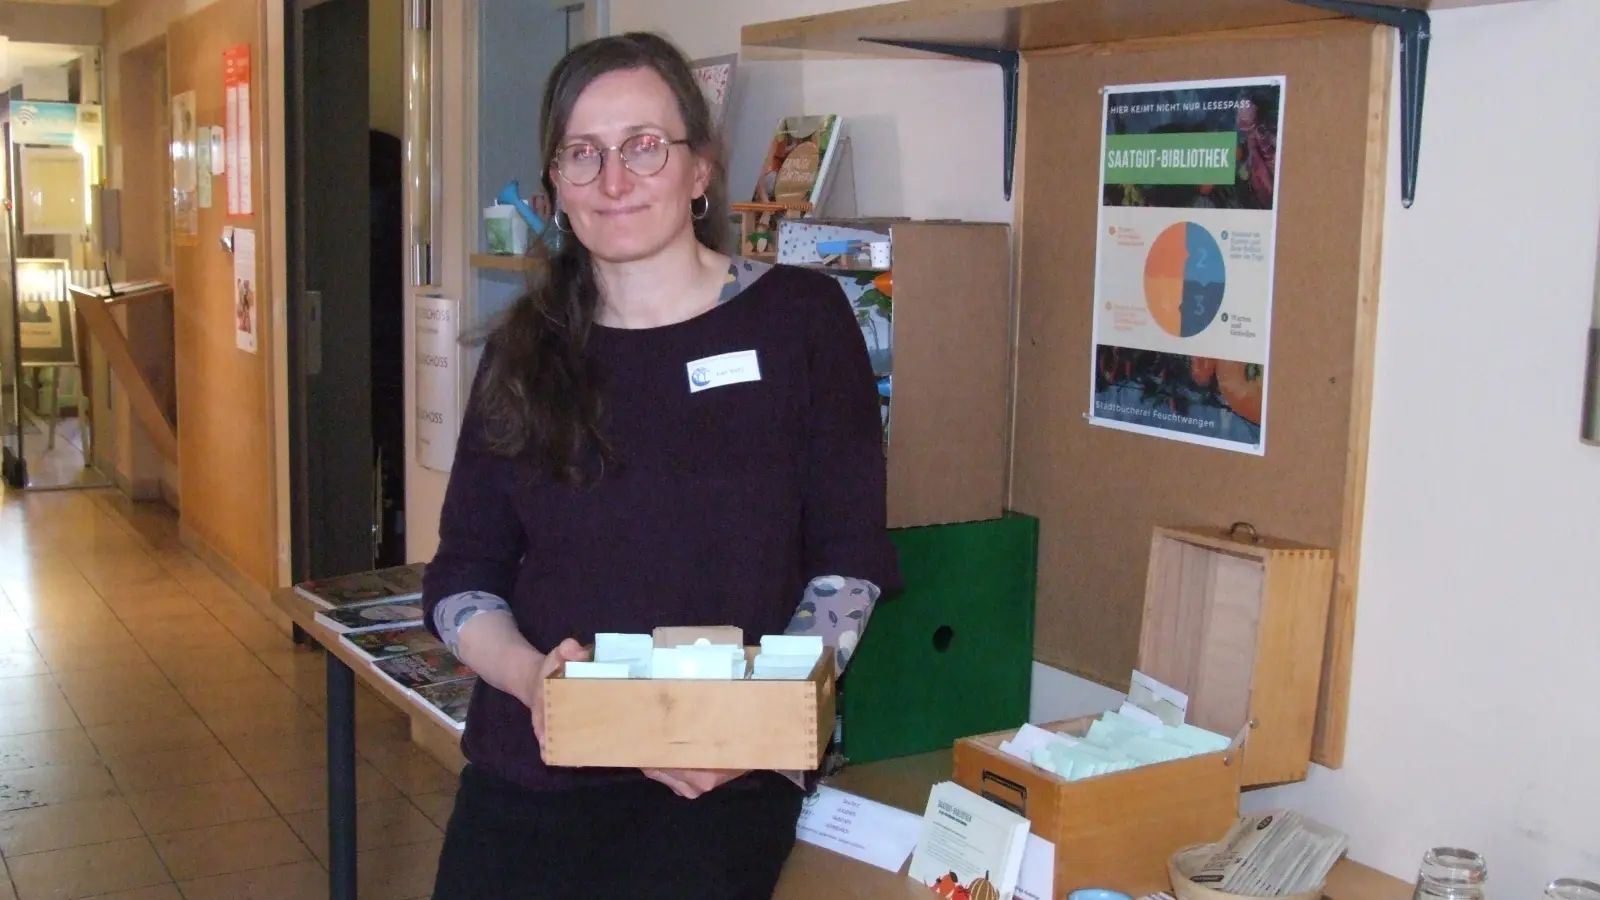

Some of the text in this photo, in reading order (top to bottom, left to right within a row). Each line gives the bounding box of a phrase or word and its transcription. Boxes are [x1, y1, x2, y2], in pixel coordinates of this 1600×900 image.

[1110, 99, 1251, 114] HIER KEIMT NICHT NUR LESESPASS
[1107, 147, 1230, 168] SAATGUT-BIBLIOTHEK
[1196, 247, 1209, 268] 2
[1193, 294, 1205, 315] 3
[1153, 410, 1214, 427] Feuchtwangen
